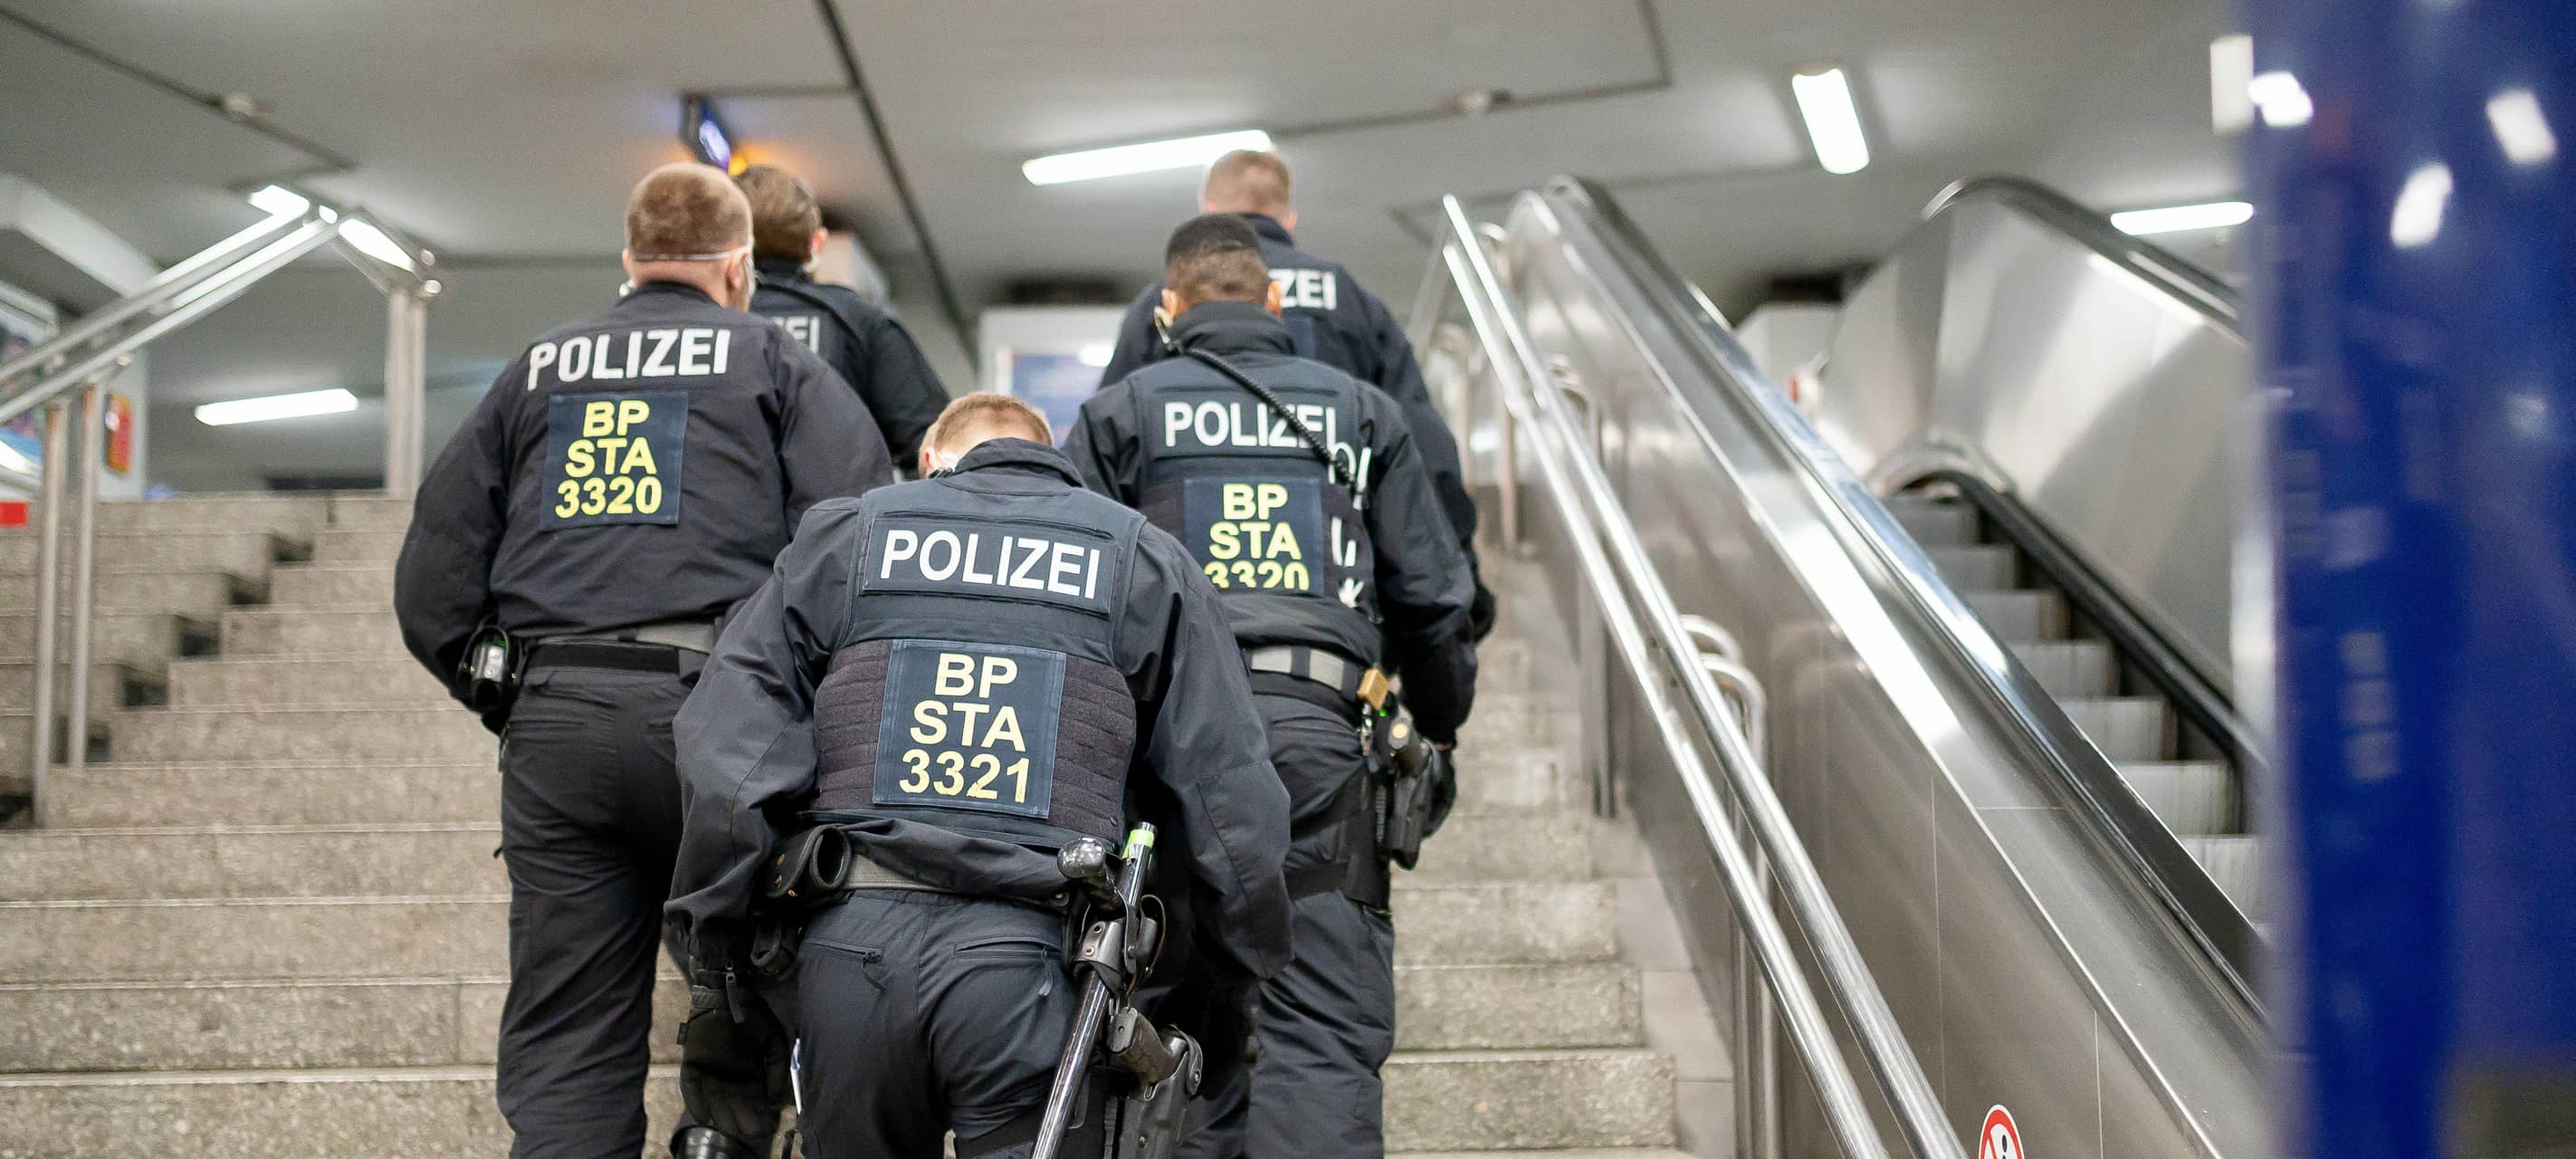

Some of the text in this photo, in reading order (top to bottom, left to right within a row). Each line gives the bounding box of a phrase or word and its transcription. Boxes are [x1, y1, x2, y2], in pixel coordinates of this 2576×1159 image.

[528, 329, 730, 391] POLIZEI
[582, 399, 650, 437] BP
[1164, 400, 1336, 446] POLIZEI
[565, 436, 657, 478] STA
[555, 475, 663, 519] 3320
[1223, 483, 1288, 521] BP
[1209, 521, 1302, 560] STA
[880, 529, 1101, 599] POLIZEI
[934, 652, 1018, 699] BP
[910, 699, 1026, 752] STA
[899, 748, 1030, 803] 3321
